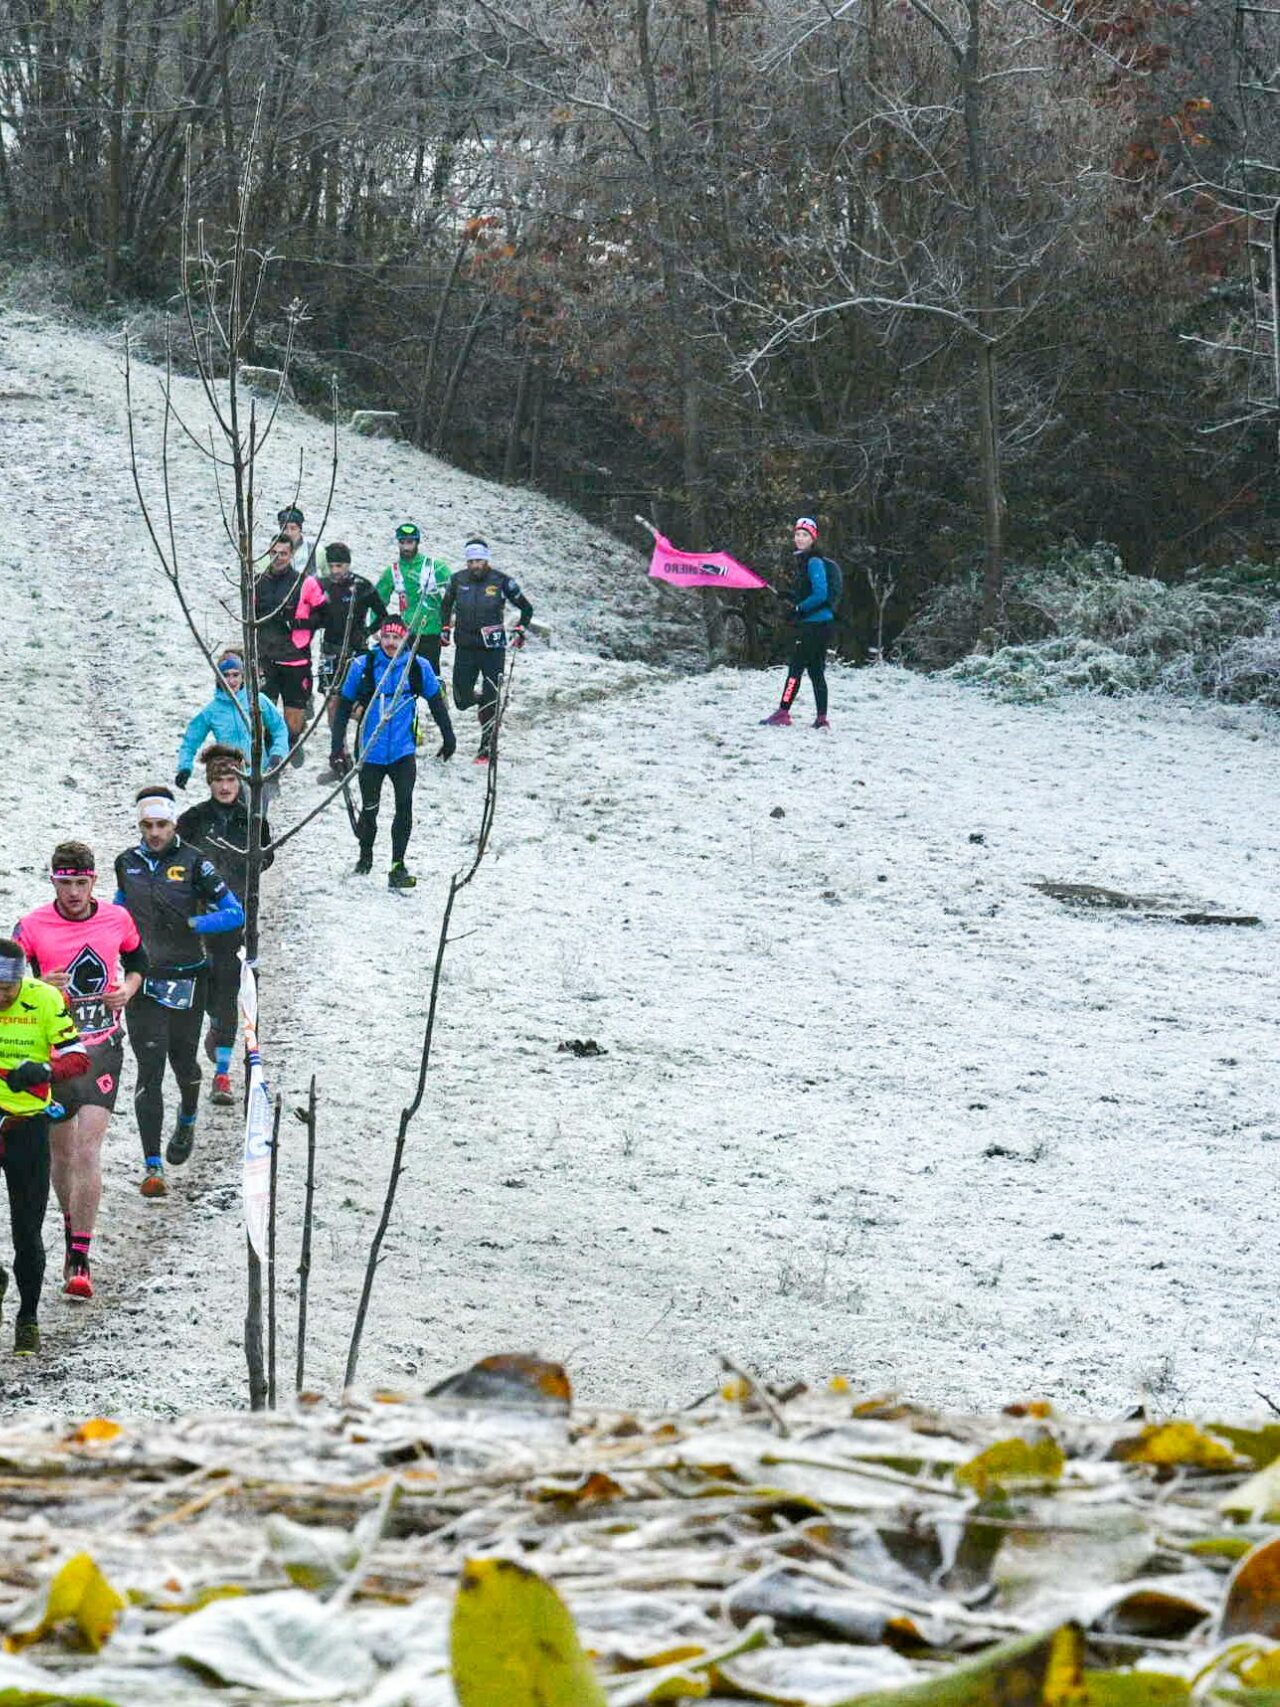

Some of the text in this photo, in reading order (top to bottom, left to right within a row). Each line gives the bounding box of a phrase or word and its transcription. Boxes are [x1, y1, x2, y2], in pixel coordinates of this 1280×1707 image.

[167, 981, 177, 994] 7
[76, 1003, 105, 1020] 171
[0, 1037, 35, 1046] Fontana
